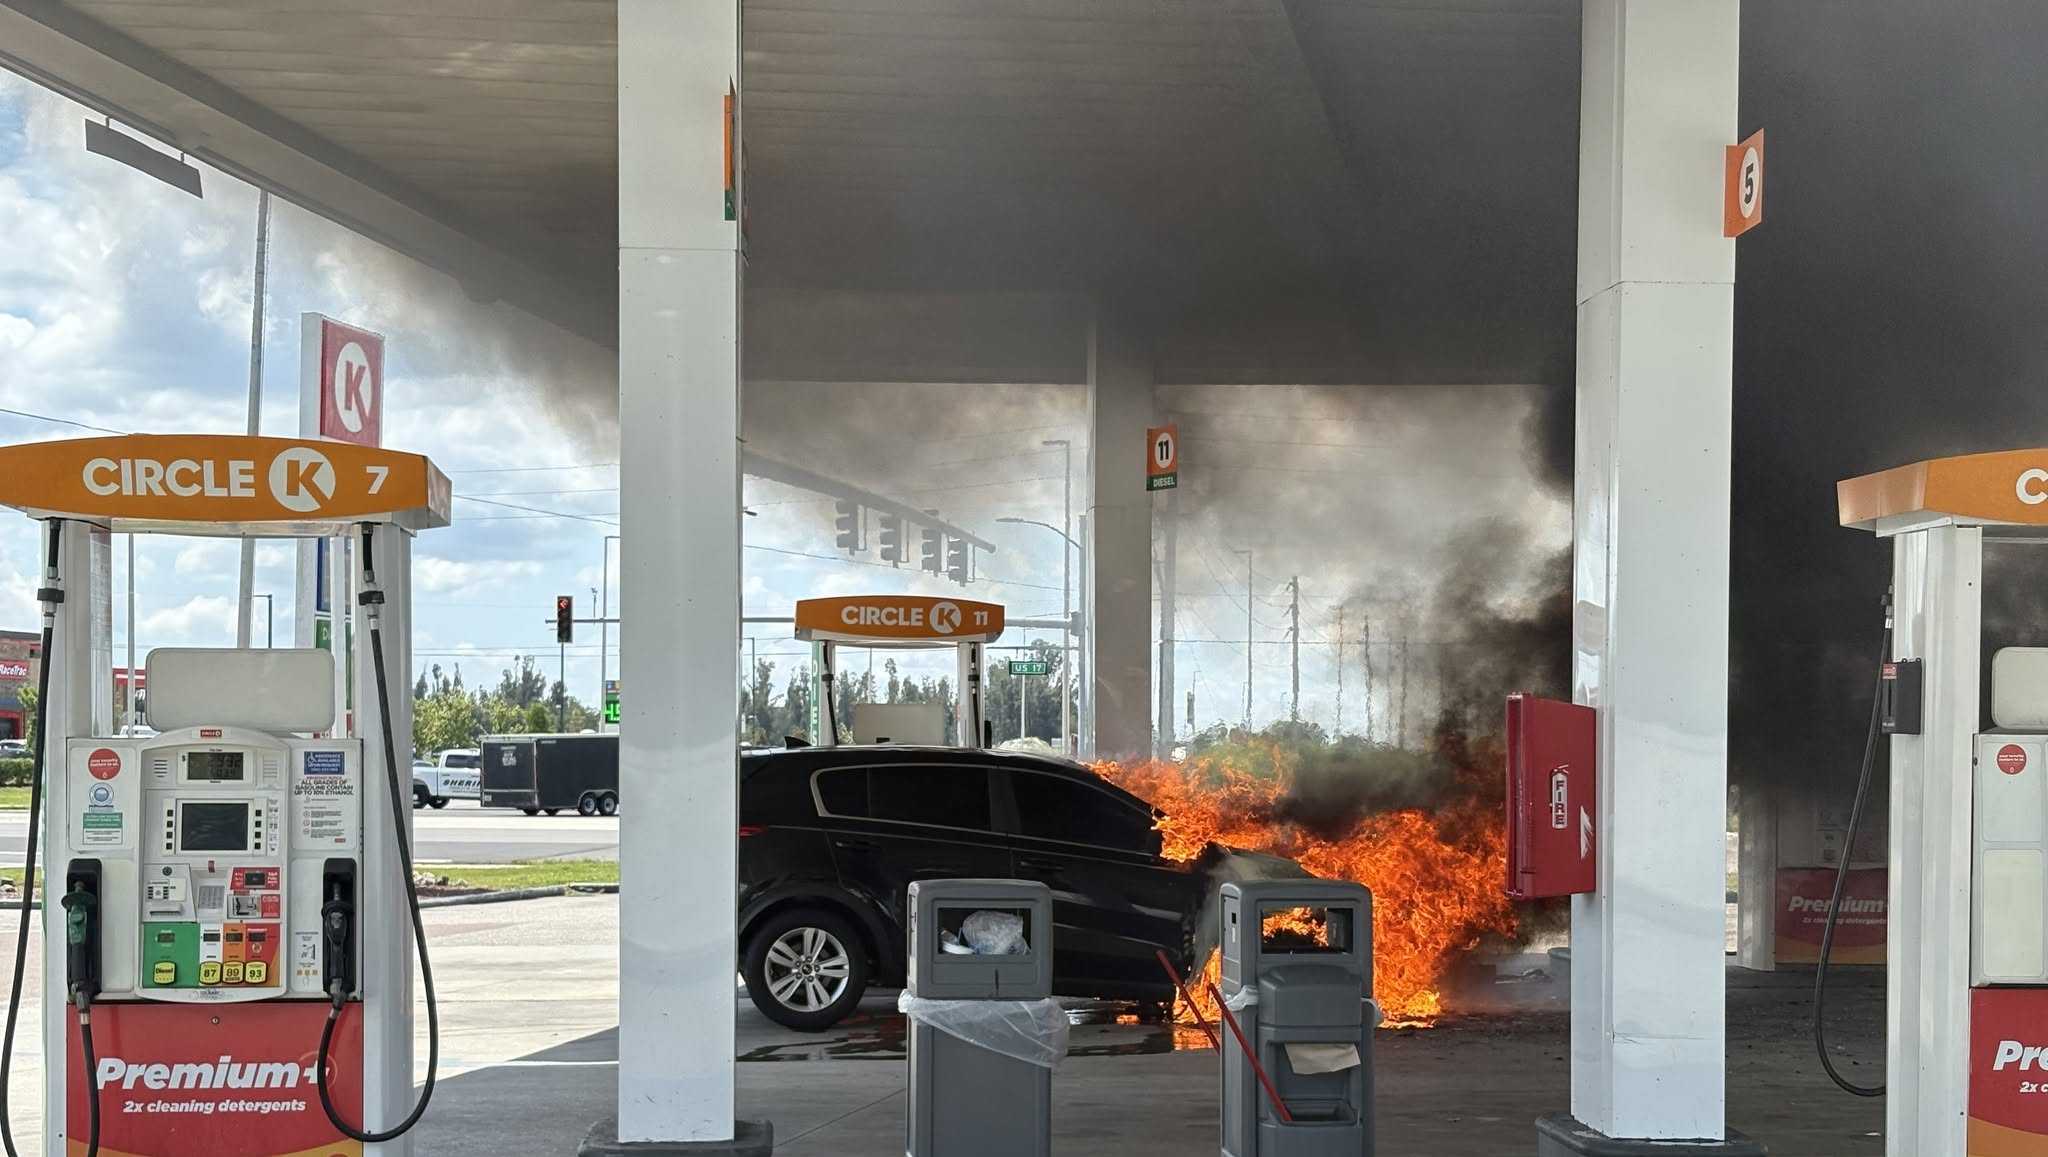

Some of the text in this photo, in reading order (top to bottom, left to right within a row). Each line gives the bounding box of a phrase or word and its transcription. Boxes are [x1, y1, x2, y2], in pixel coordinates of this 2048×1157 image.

[1743, 162, 1754, 205] 5
[1158, 439, 1169, 461] 11
[82, 447, 389, 513] CIRCLE K 7
[1153, 476, 1175, 488] DIESEL
[841, 601, 988, 634] CIRCLE K 11
[1015, 663, 1042, 672] US 17
[1555, 780, 1565, 826] FIRE
[155, 967, 174, 975] Diesel
[203, 968, 217, 978] 87
[226, 968, 240, 977] 89
[249, 968, 262, 978] 93
[2019, 1081, 2038, 1093] 2x
[123, 1098, 306, 1114] 2x cleaning detergents
